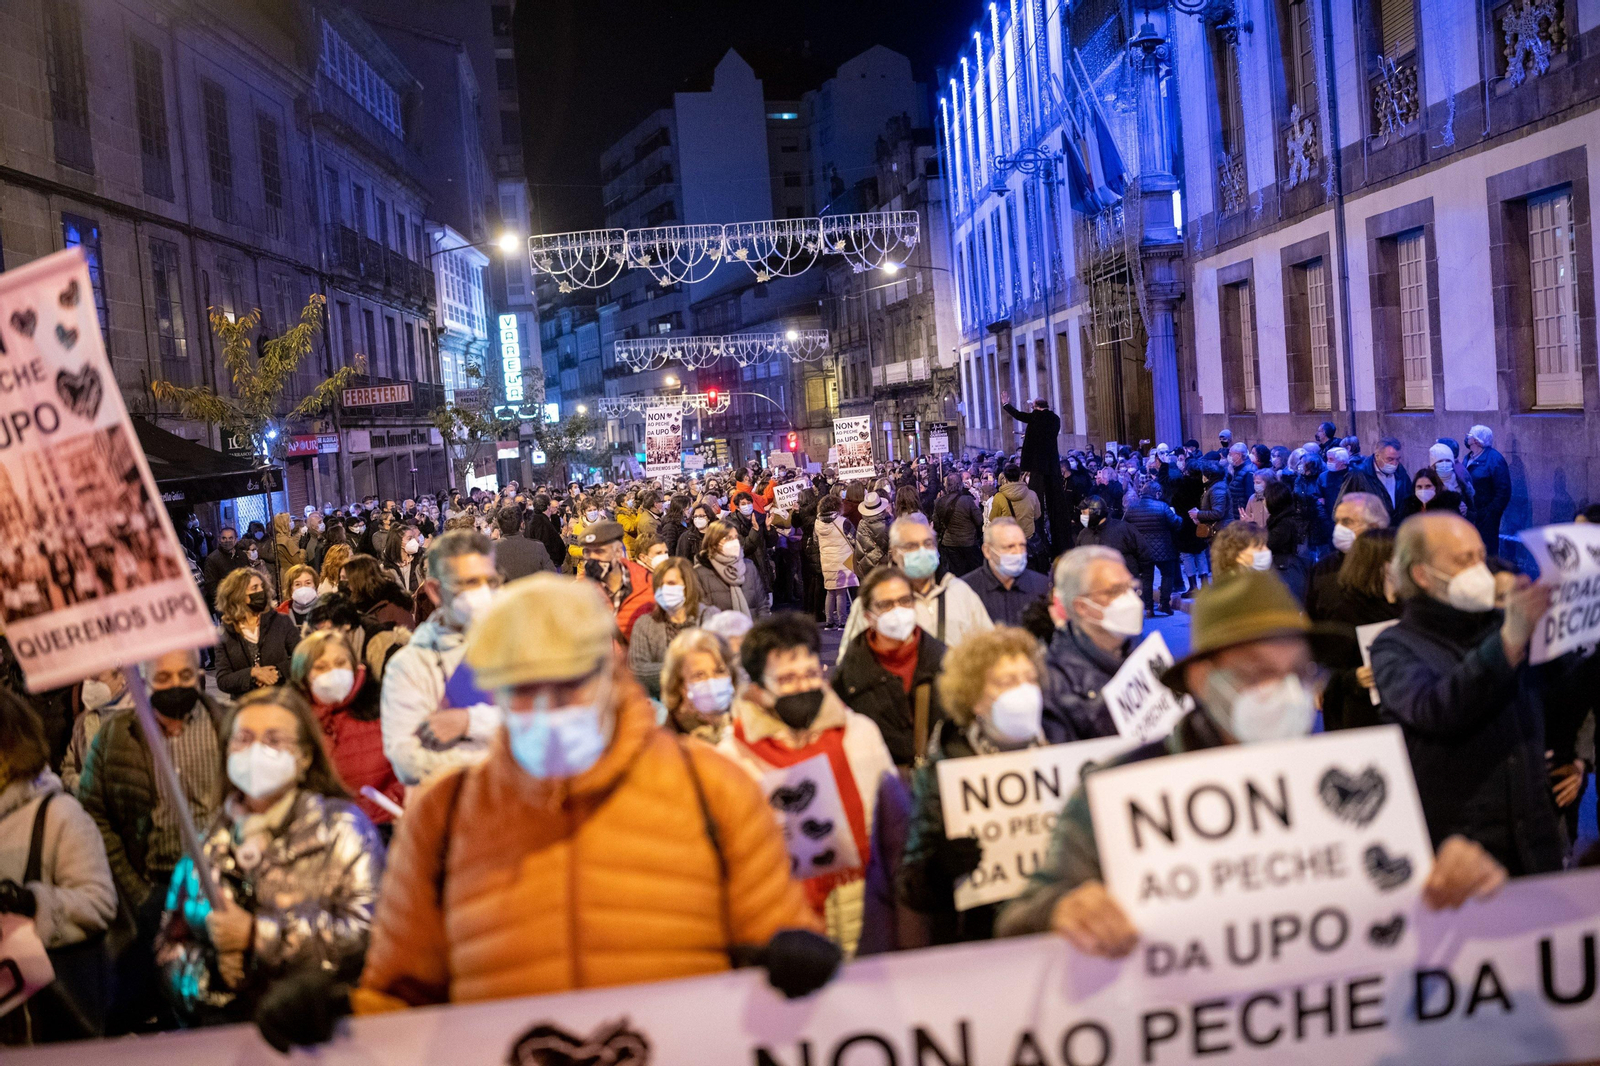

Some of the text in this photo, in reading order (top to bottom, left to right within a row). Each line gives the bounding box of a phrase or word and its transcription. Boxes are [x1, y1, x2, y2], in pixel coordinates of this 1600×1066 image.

[503, 316, 520, 398] VARELA
[345, 385, 407, 406] FERRETERIA
[648, 413, 666, 421] NON
[655, 428, 670, 436] UPO
[835, 422, 853, 430] NON
[844, 435, 859, 443] UPO
[776, 485, 795, 496] NON
[16, 592, 198, 659] QUEREMOS UPO
[1116, 669, 1151, 722] NON
[961, 767, 1060, 812] NON
[1009, 811, 1058, 838] PEC
[1126, 775, 1292, 850] NON
[971, 863, 1007, 888] DA
[1139, 842, 1345, 902] AO PECHE
[1144, 906, 1350, 978] DA UPO
[1009, 1020, 1114, 1066] AO
[1140, 976, 1388, 1064] PECHE
[1413, 959, 1513, 1023] DA
[1538, 933, 1599, 1008] U
